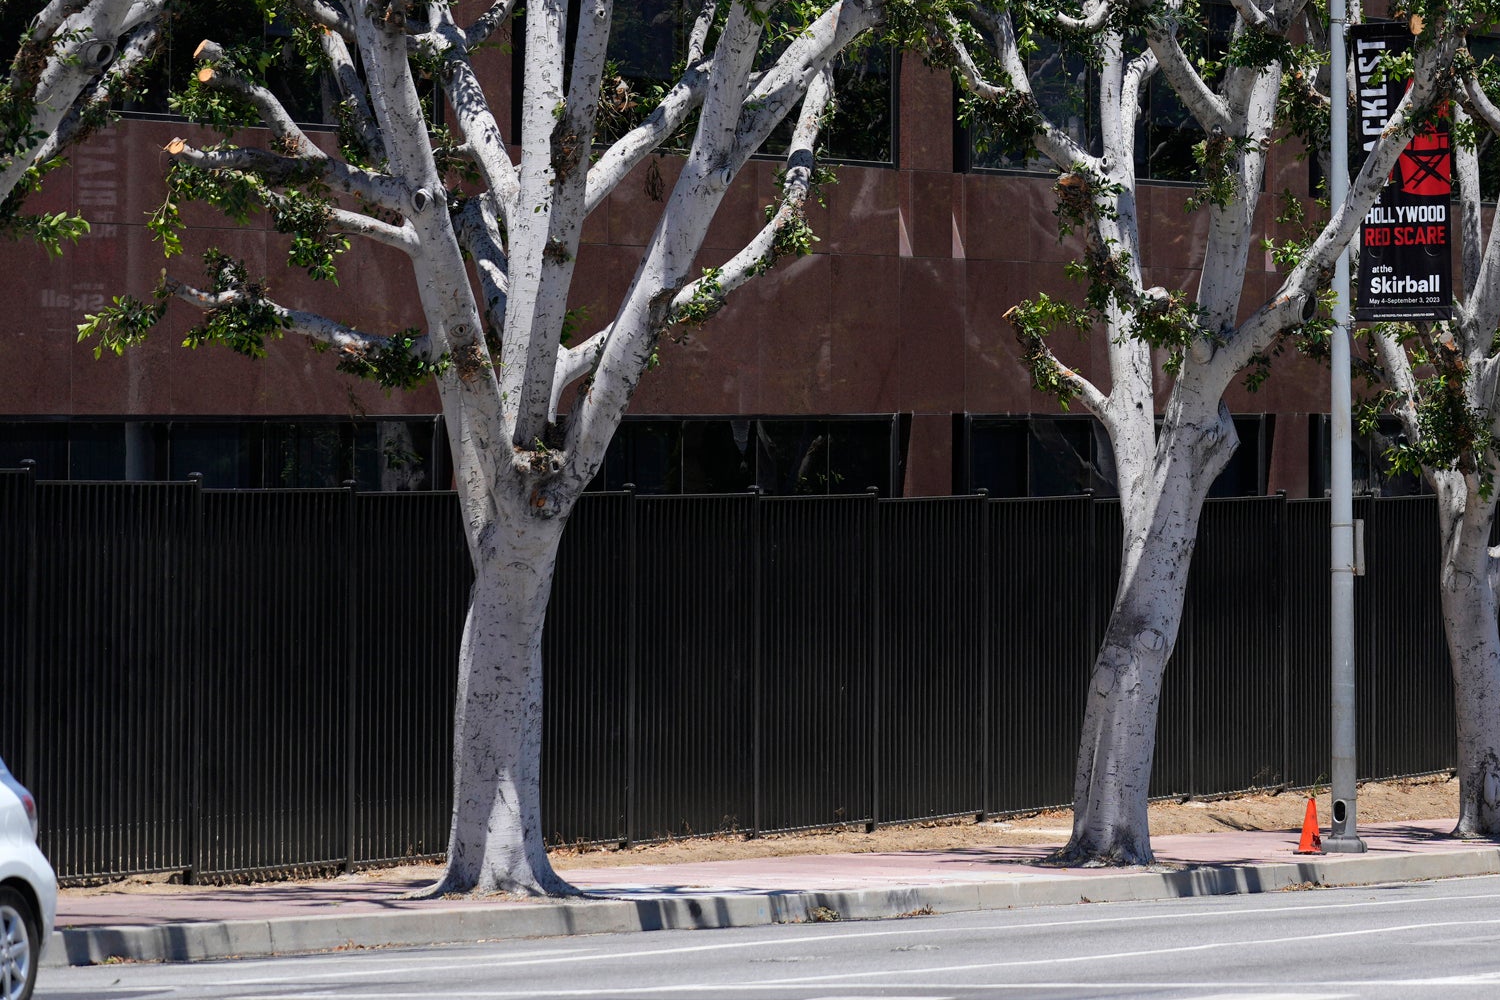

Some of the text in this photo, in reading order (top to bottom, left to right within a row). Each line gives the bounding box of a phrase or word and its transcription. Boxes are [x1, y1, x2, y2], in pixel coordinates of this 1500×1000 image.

[1365, 205, 1446, 225] HOLLYWOOD
[1365, 226, 1446, 246] RED SCARE
[1372, 264, 1393, 274] at the
[1370, 274, 1440, 294] Skirball
